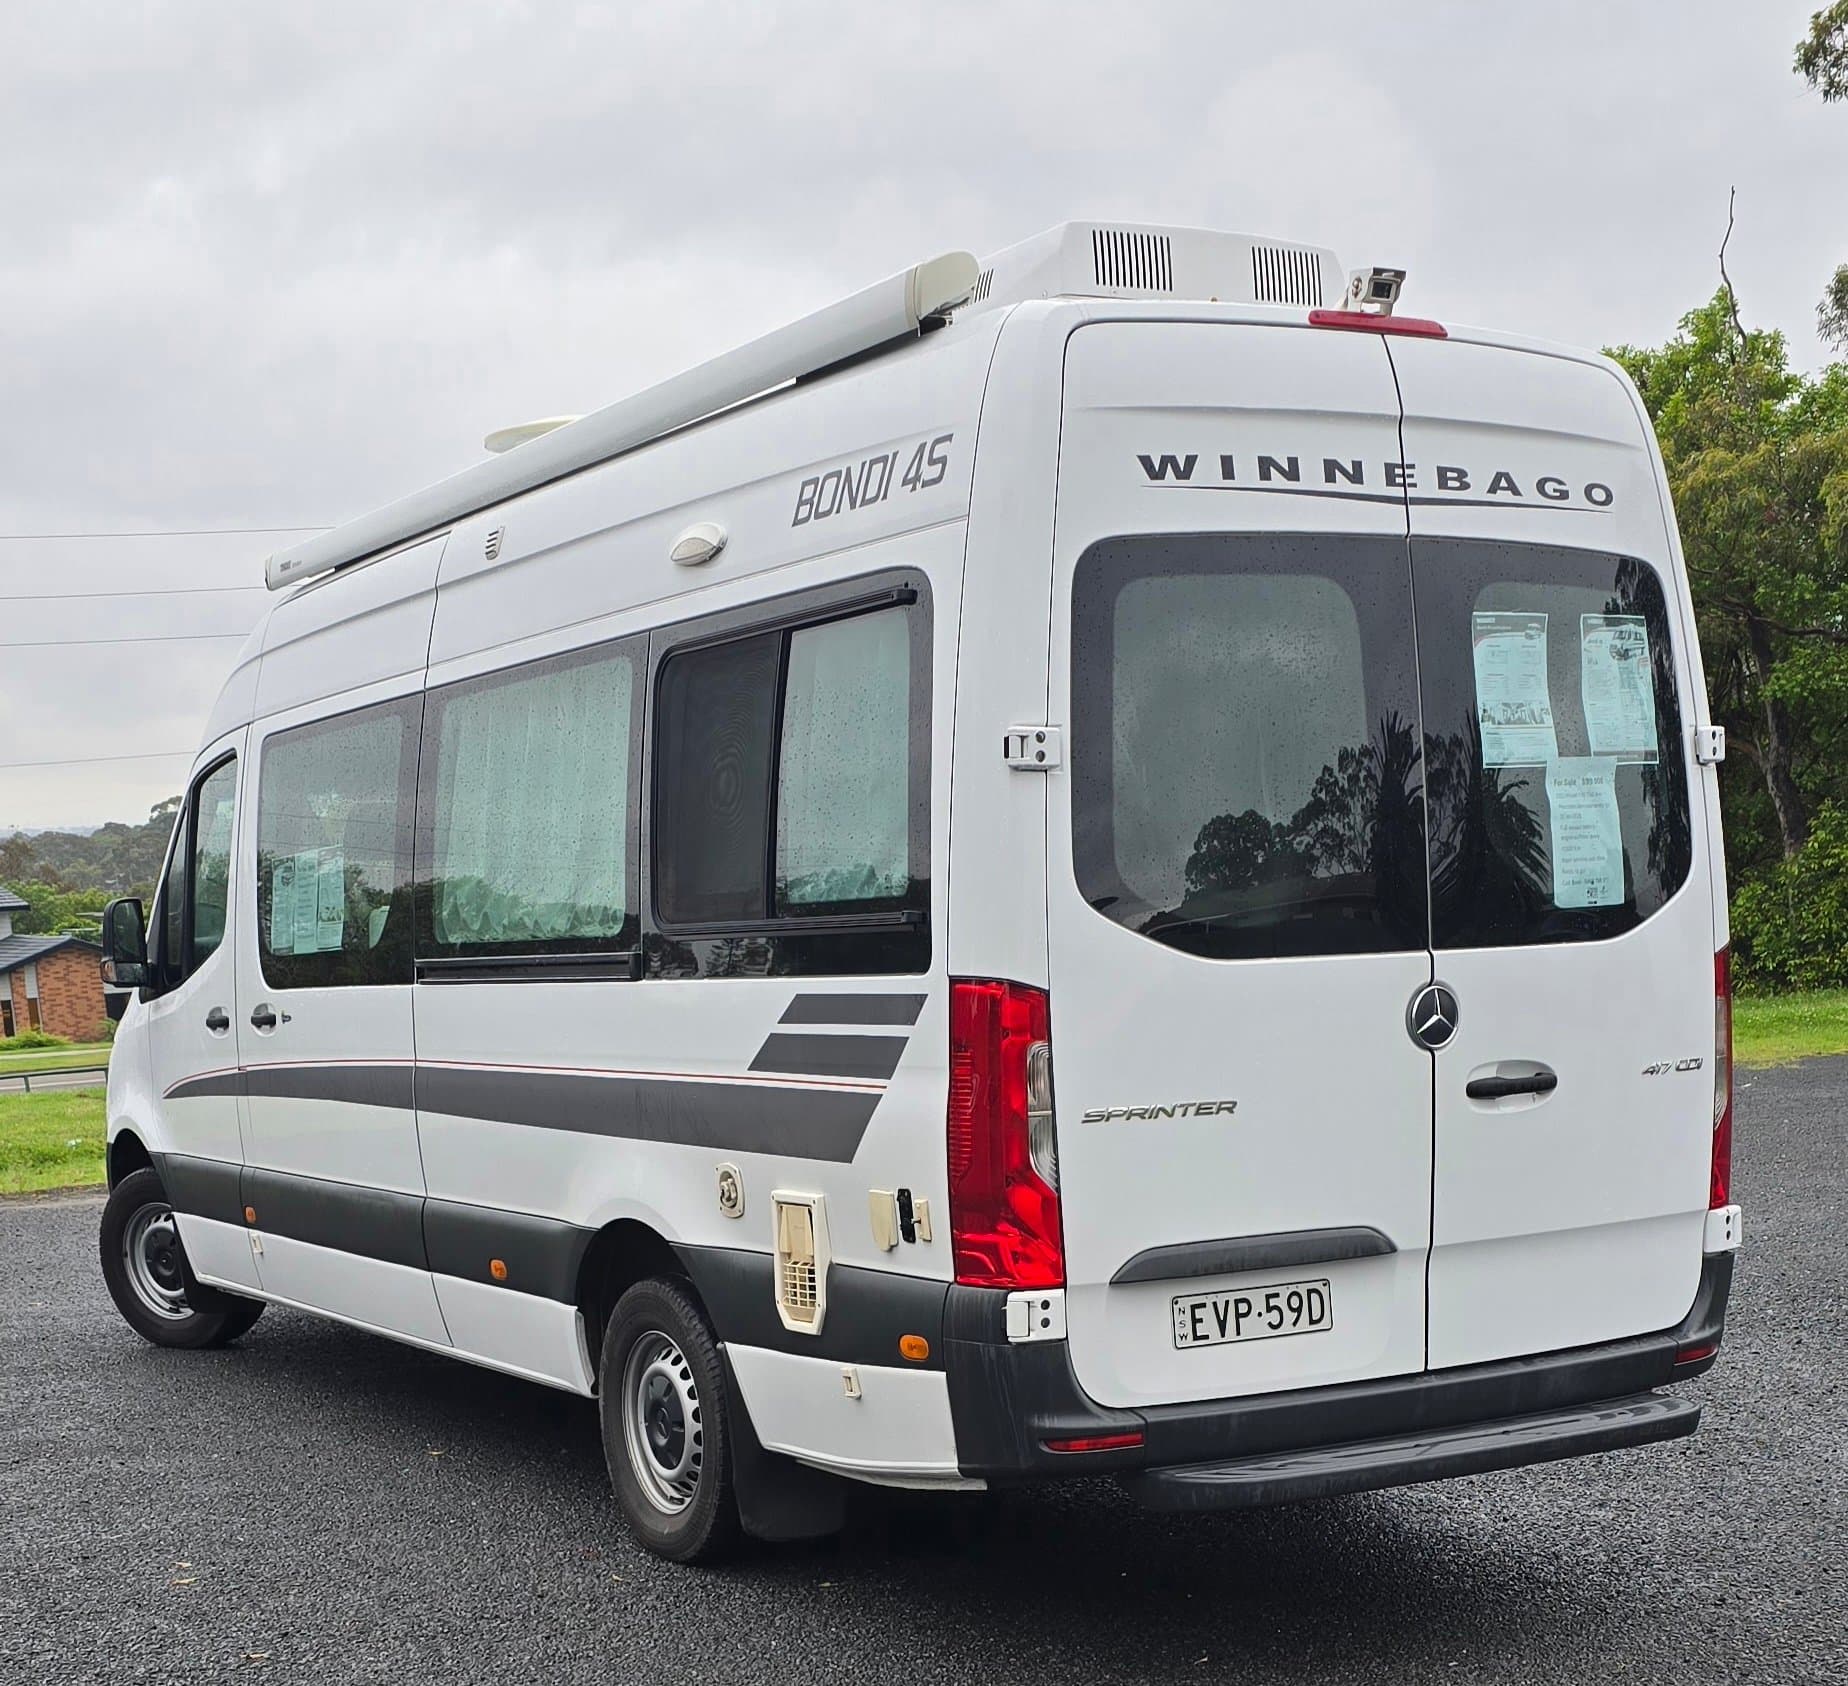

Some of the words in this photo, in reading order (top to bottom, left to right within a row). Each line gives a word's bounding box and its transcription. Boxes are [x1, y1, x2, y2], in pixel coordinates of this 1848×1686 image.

[792, 449, 899, 527] BONDI
[901, 432, 954, 493] 4S
[1136, 453, 1615, 508] WINNEBAGO
[1553, 778, 1563, 787] For
[1642, 1061, 1673, 1076] 417
[1081, 1100, 1238, 1124] SPRINTER
